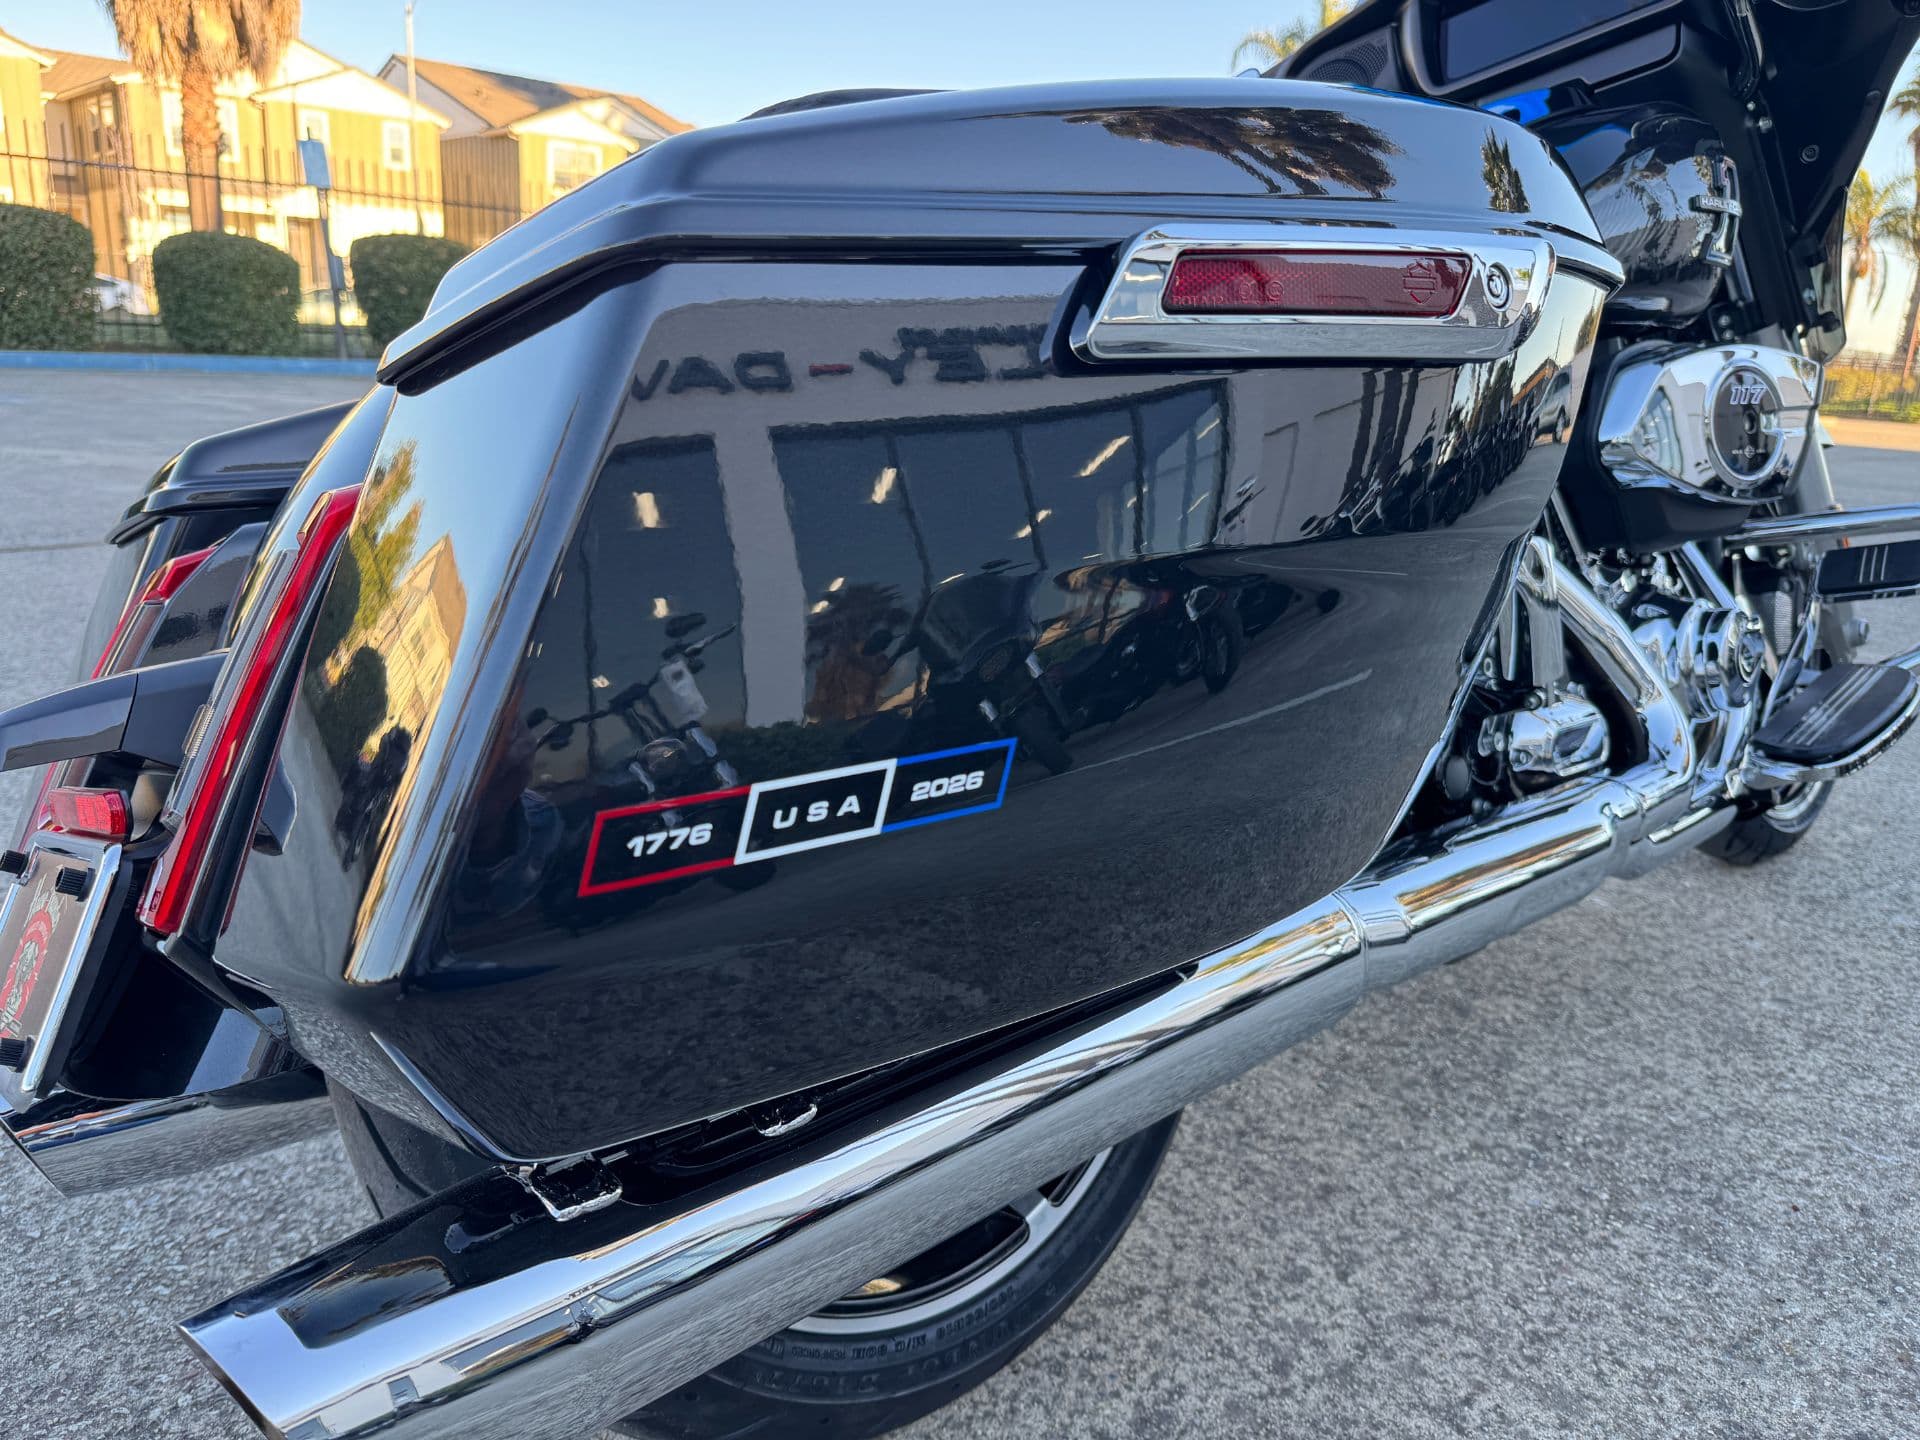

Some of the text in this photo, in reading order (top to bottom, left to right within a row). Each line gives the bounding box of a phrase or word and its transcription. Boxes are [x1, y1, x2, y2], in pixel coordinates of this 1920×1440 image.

[1729, 385, 1767, 405] 117
[626, 770, 985, 857] 1776 USA 2026
